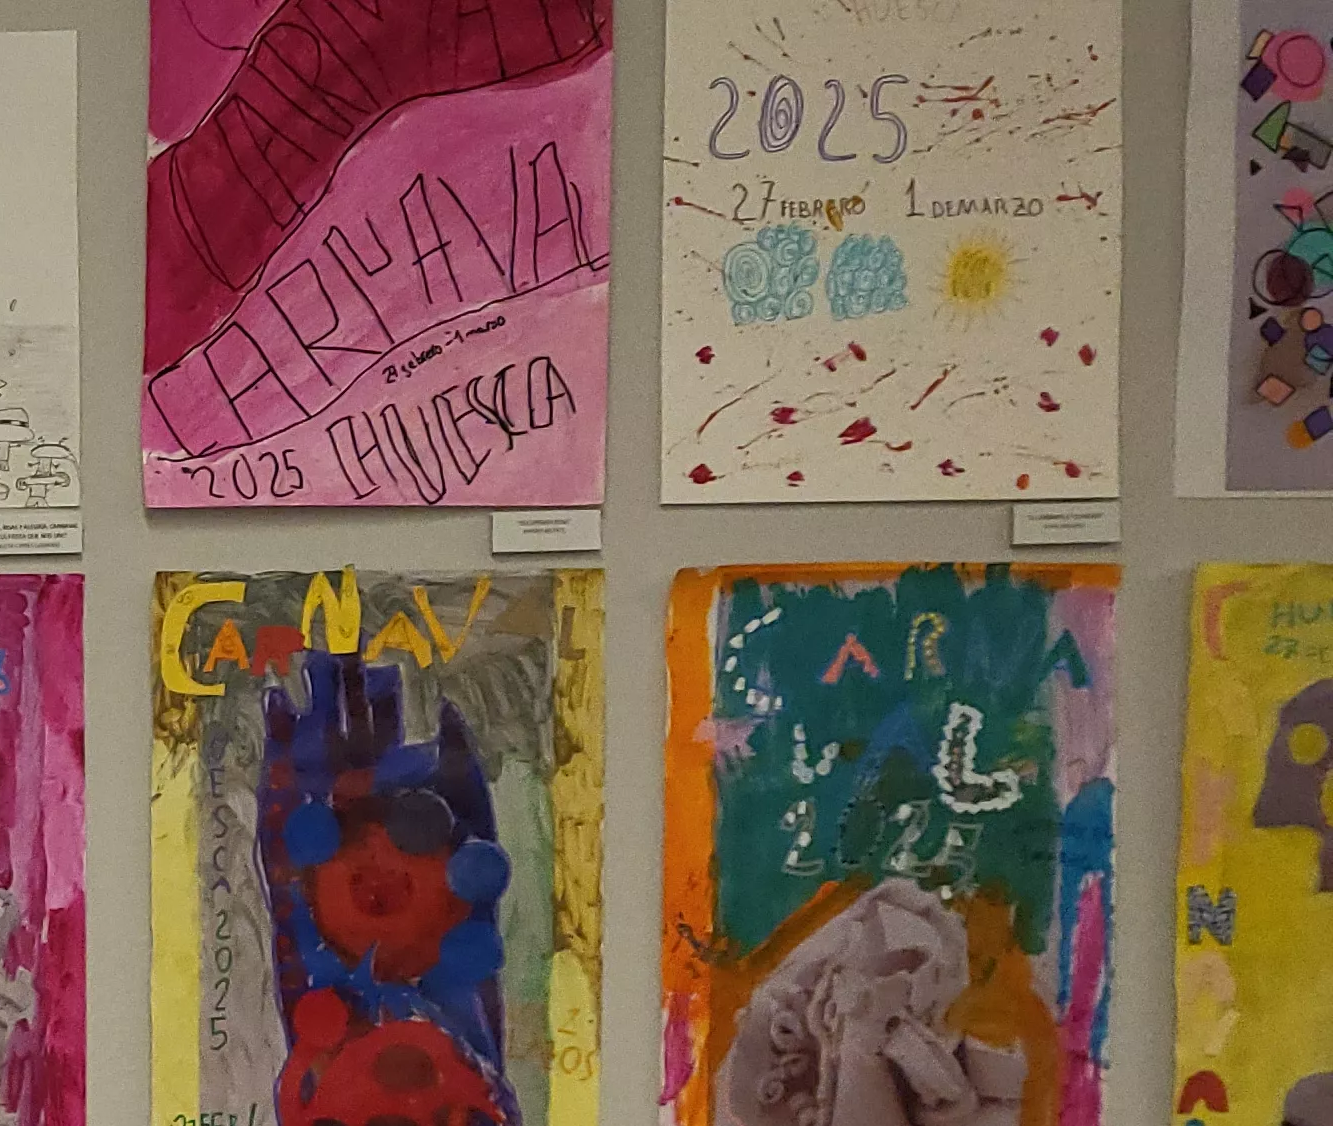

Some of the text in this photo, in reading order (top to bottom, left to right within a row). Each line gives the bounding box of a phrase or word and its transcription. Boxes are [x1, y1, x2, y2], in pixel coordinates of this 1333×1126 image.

[708, 74, 912, 165] 2025
[732, 180, 776, 222] 27
[905, 177, 925, 218] 1
[182, 449, 304, 500] 2025
